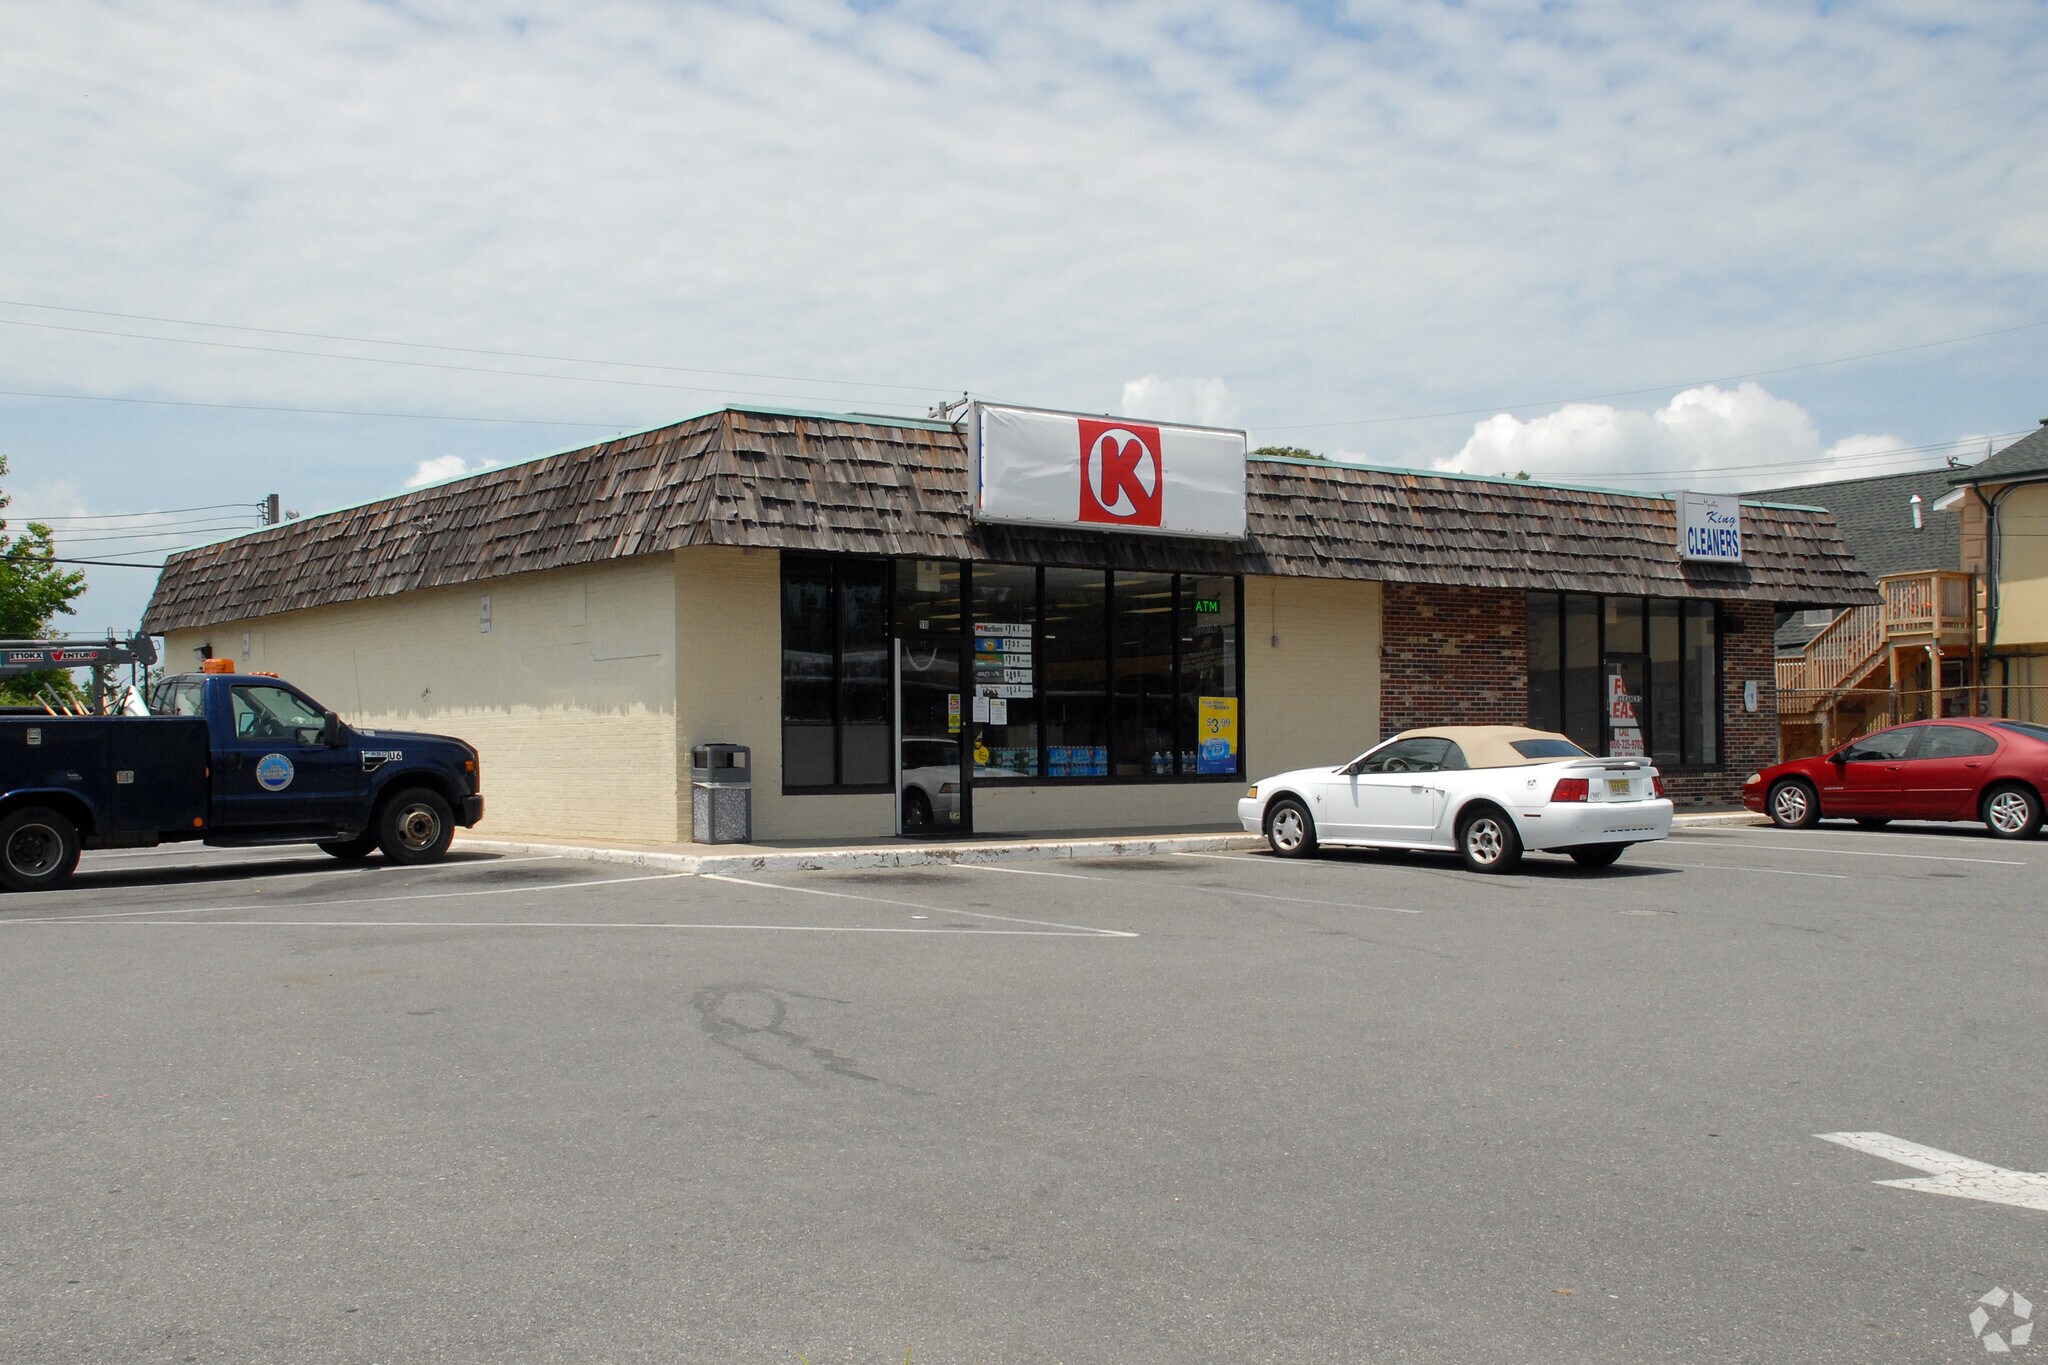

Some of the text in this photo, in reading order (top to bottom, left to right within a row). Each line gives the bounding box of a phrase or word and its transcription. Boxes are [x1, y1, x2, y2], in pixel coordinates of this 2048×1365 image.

[1101, 435, 1151, 512] K
[1706, 511, 1736, 527] King
[1687, 526, 1739, 557] CLEANERS
[1195, 600, 1217, 612] ATM
[983, 624, 1003, 632] Marlboro
[1614, 678, 1627, 695] FO
[1611, 702, 1636, 719] EAS
[390, 751, 402, 760] U6
